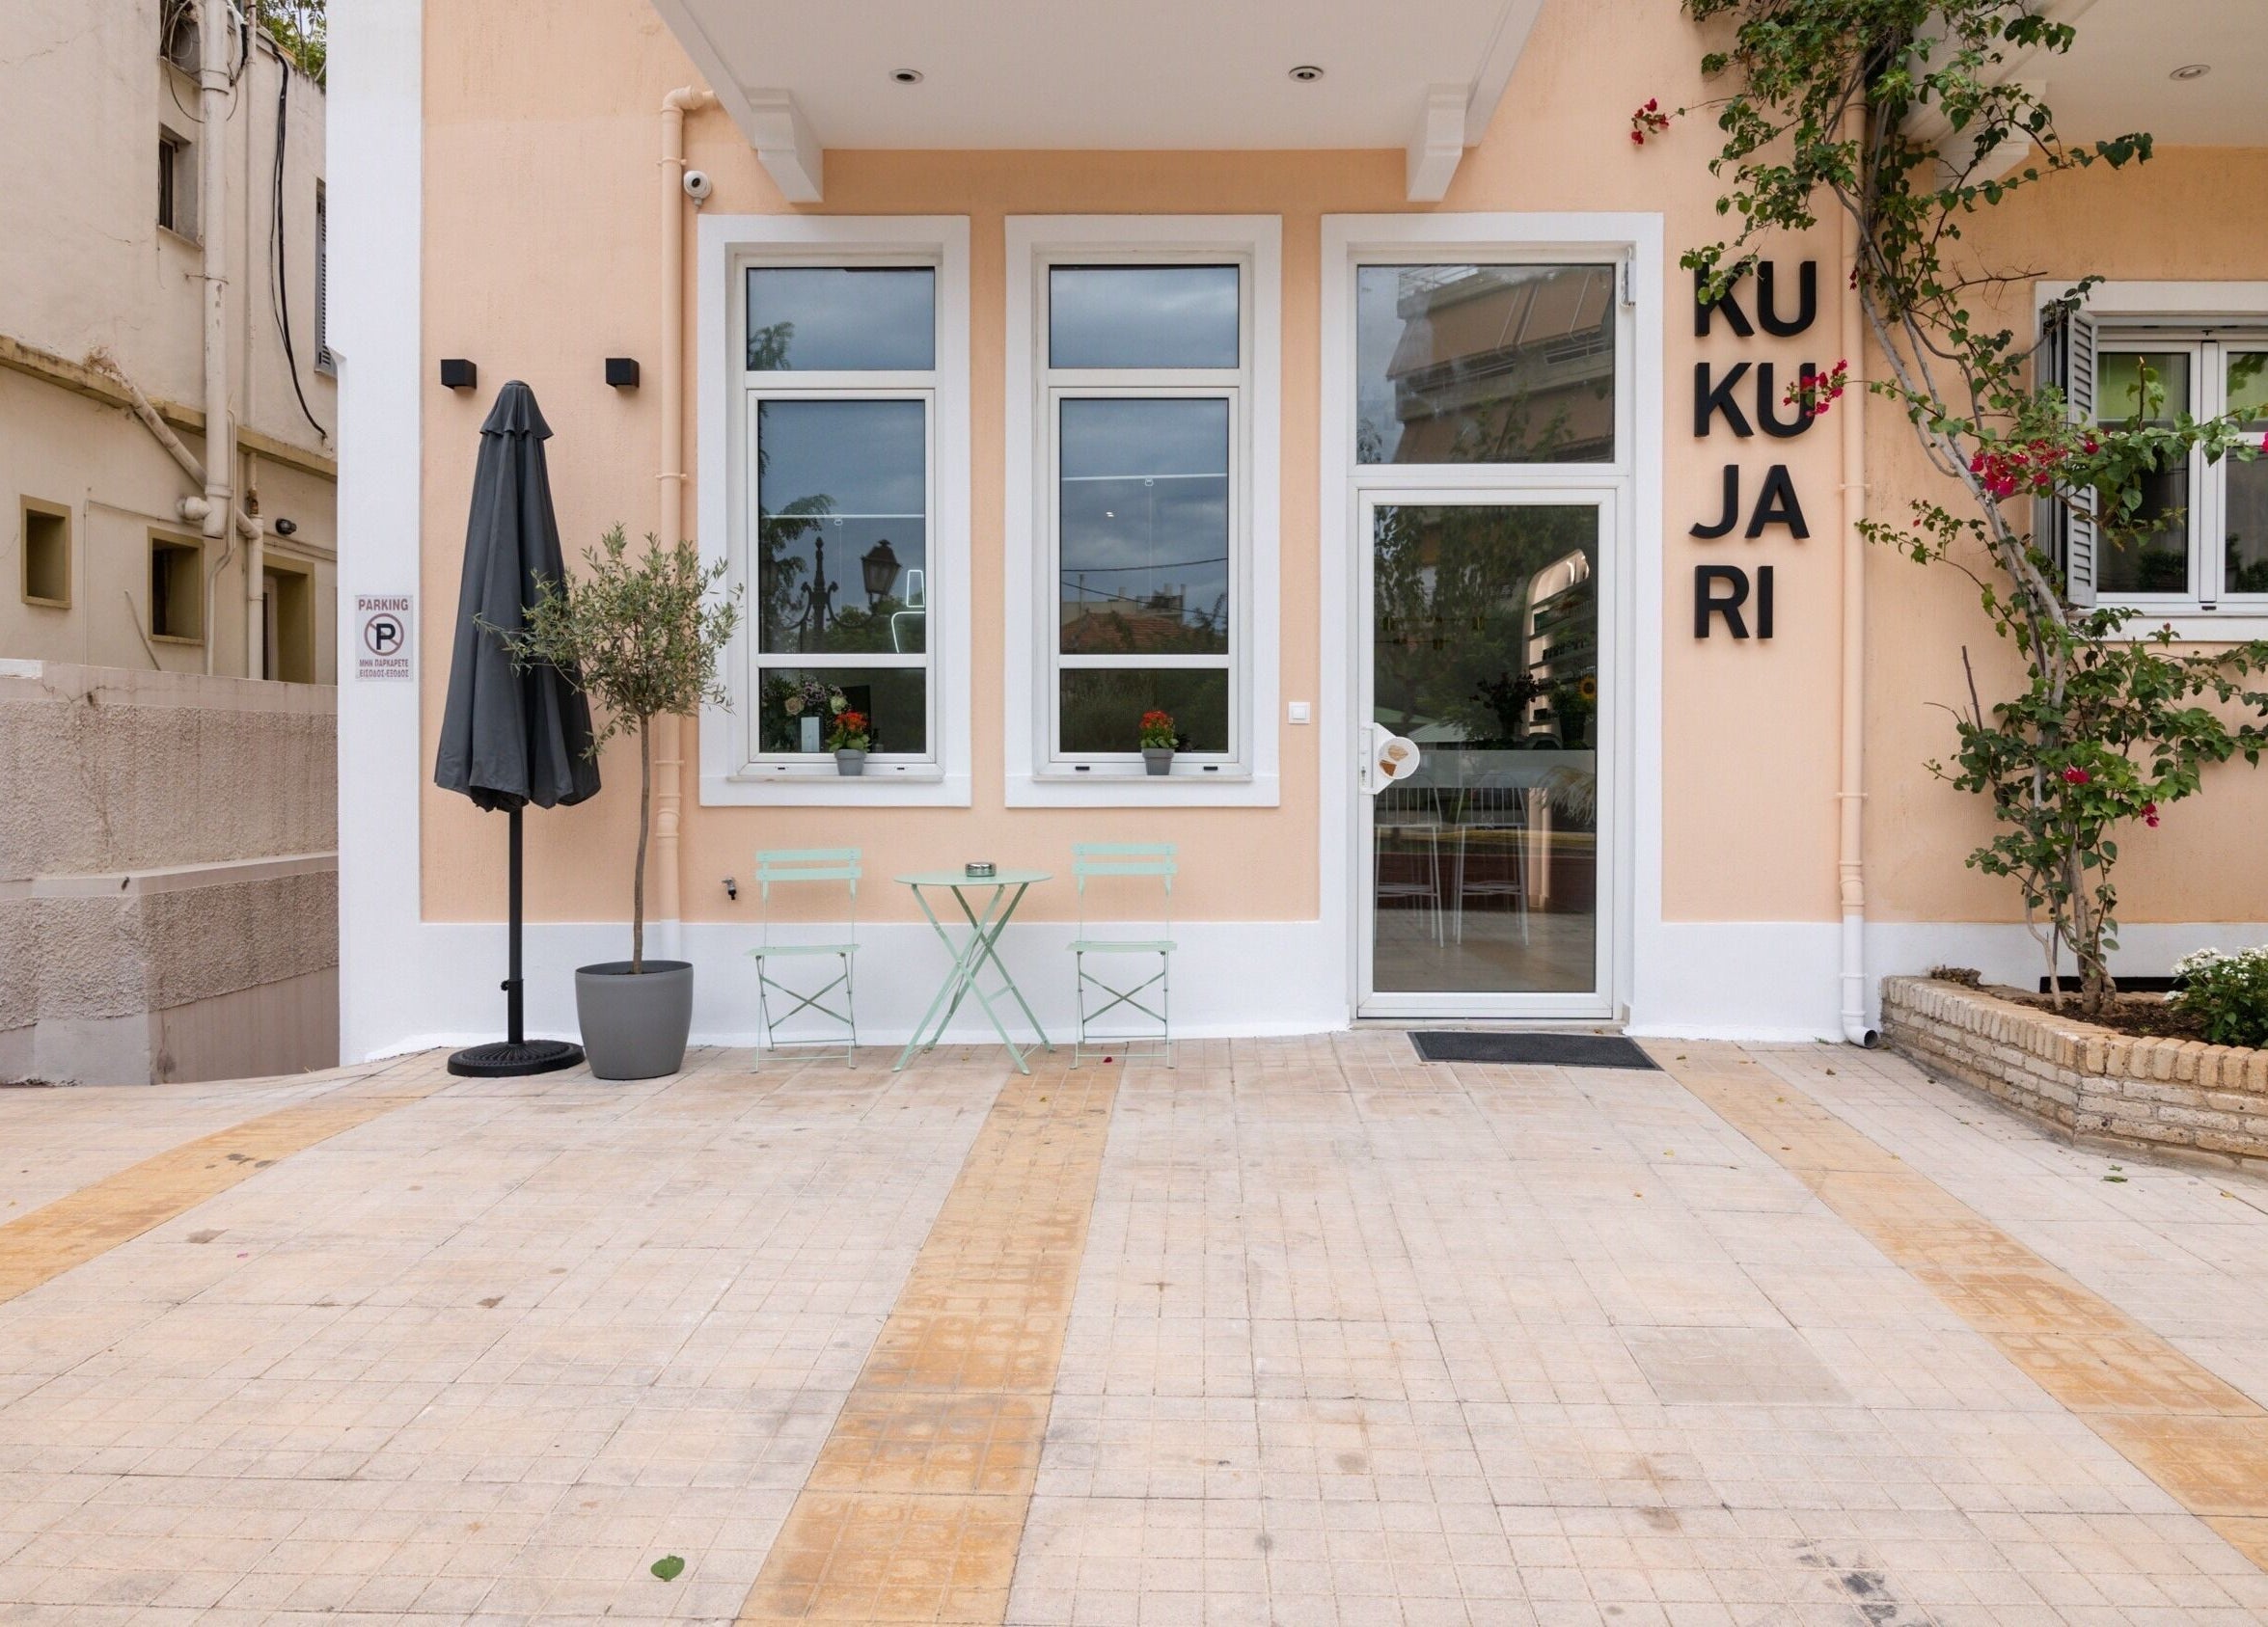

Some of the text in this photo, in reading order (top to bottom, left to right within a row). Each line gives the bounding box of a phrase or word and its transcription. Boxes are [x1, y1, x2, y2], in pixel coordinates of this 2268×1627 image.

[1694, 261, 1817, 338] KU
[1694, 363, 1816, 438] KU
[1688, 465, 1810, 540] JA
[358, 598, 409, 611] PARKING
[1694, 565, 1773, 639] RI
